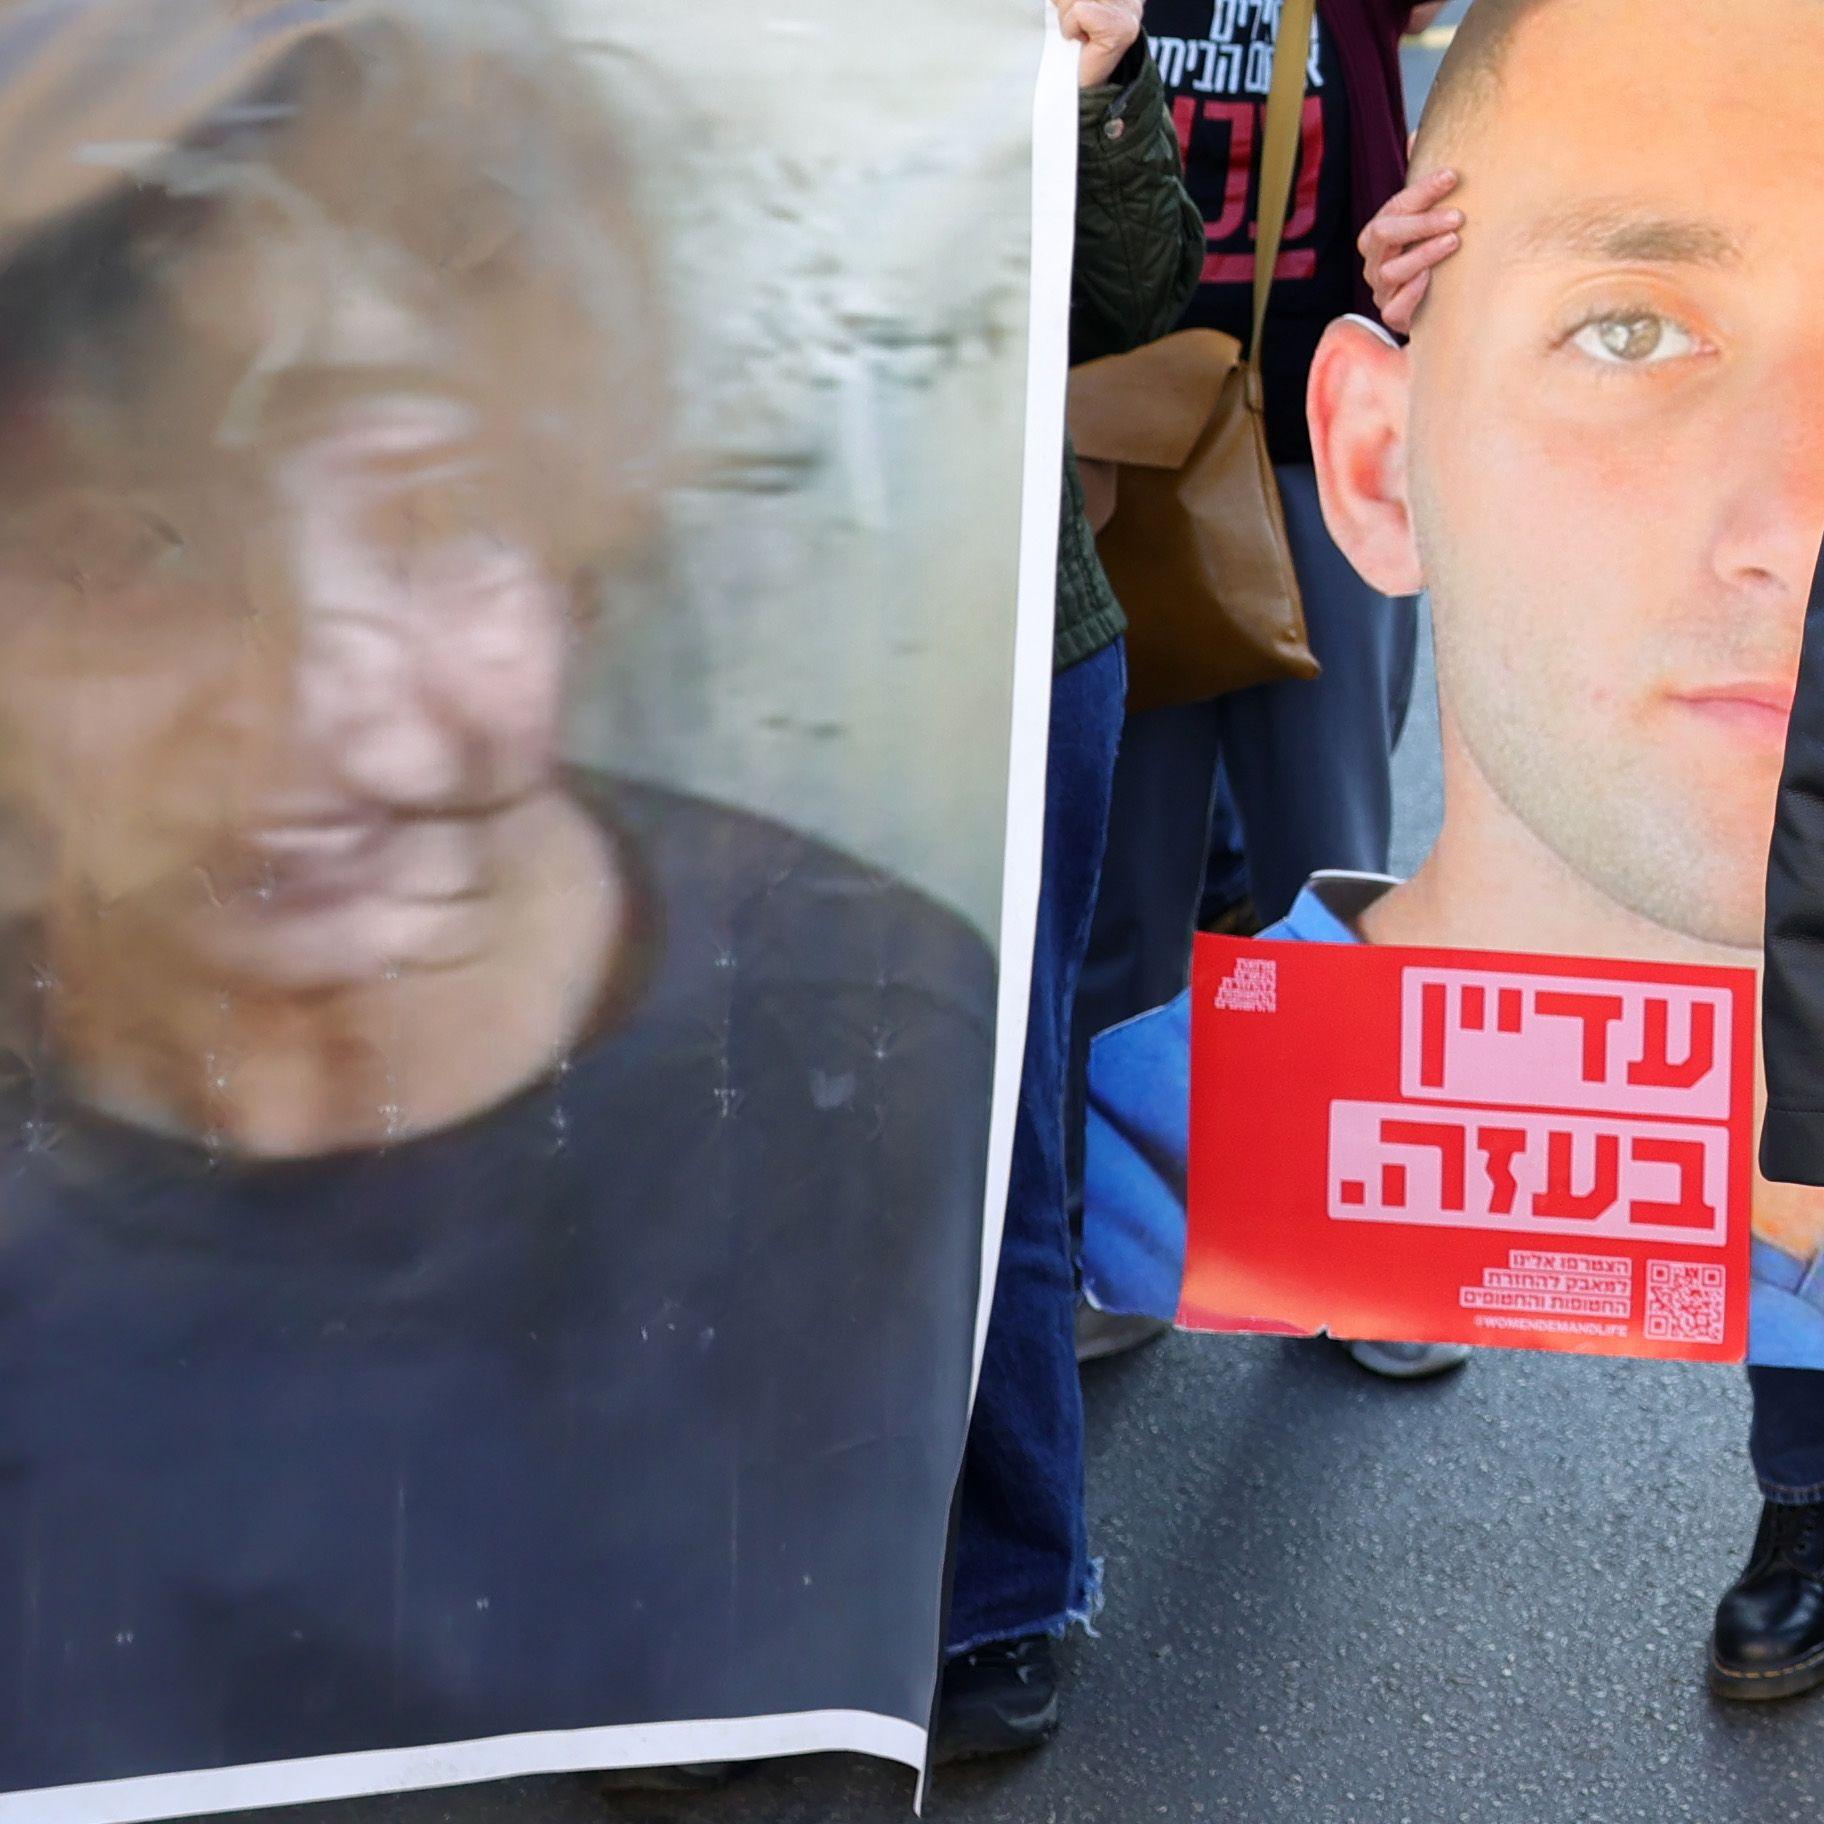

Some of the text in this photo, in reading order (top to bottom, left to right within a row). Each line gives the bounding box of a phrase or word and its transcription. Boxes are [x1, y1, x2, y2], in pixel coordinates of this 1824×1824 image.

[1420, 982, 1716, 1089] עדיין
[1339, 1118, 1717, 1230] בעזה.
[1512, 1252, 1629, 1274] הצטרפו אלינו
[1487, 1271, 1628, 1294] למאבק להחזרת
[1463, 1290, 1628, 1315] החטופות והחטופים
